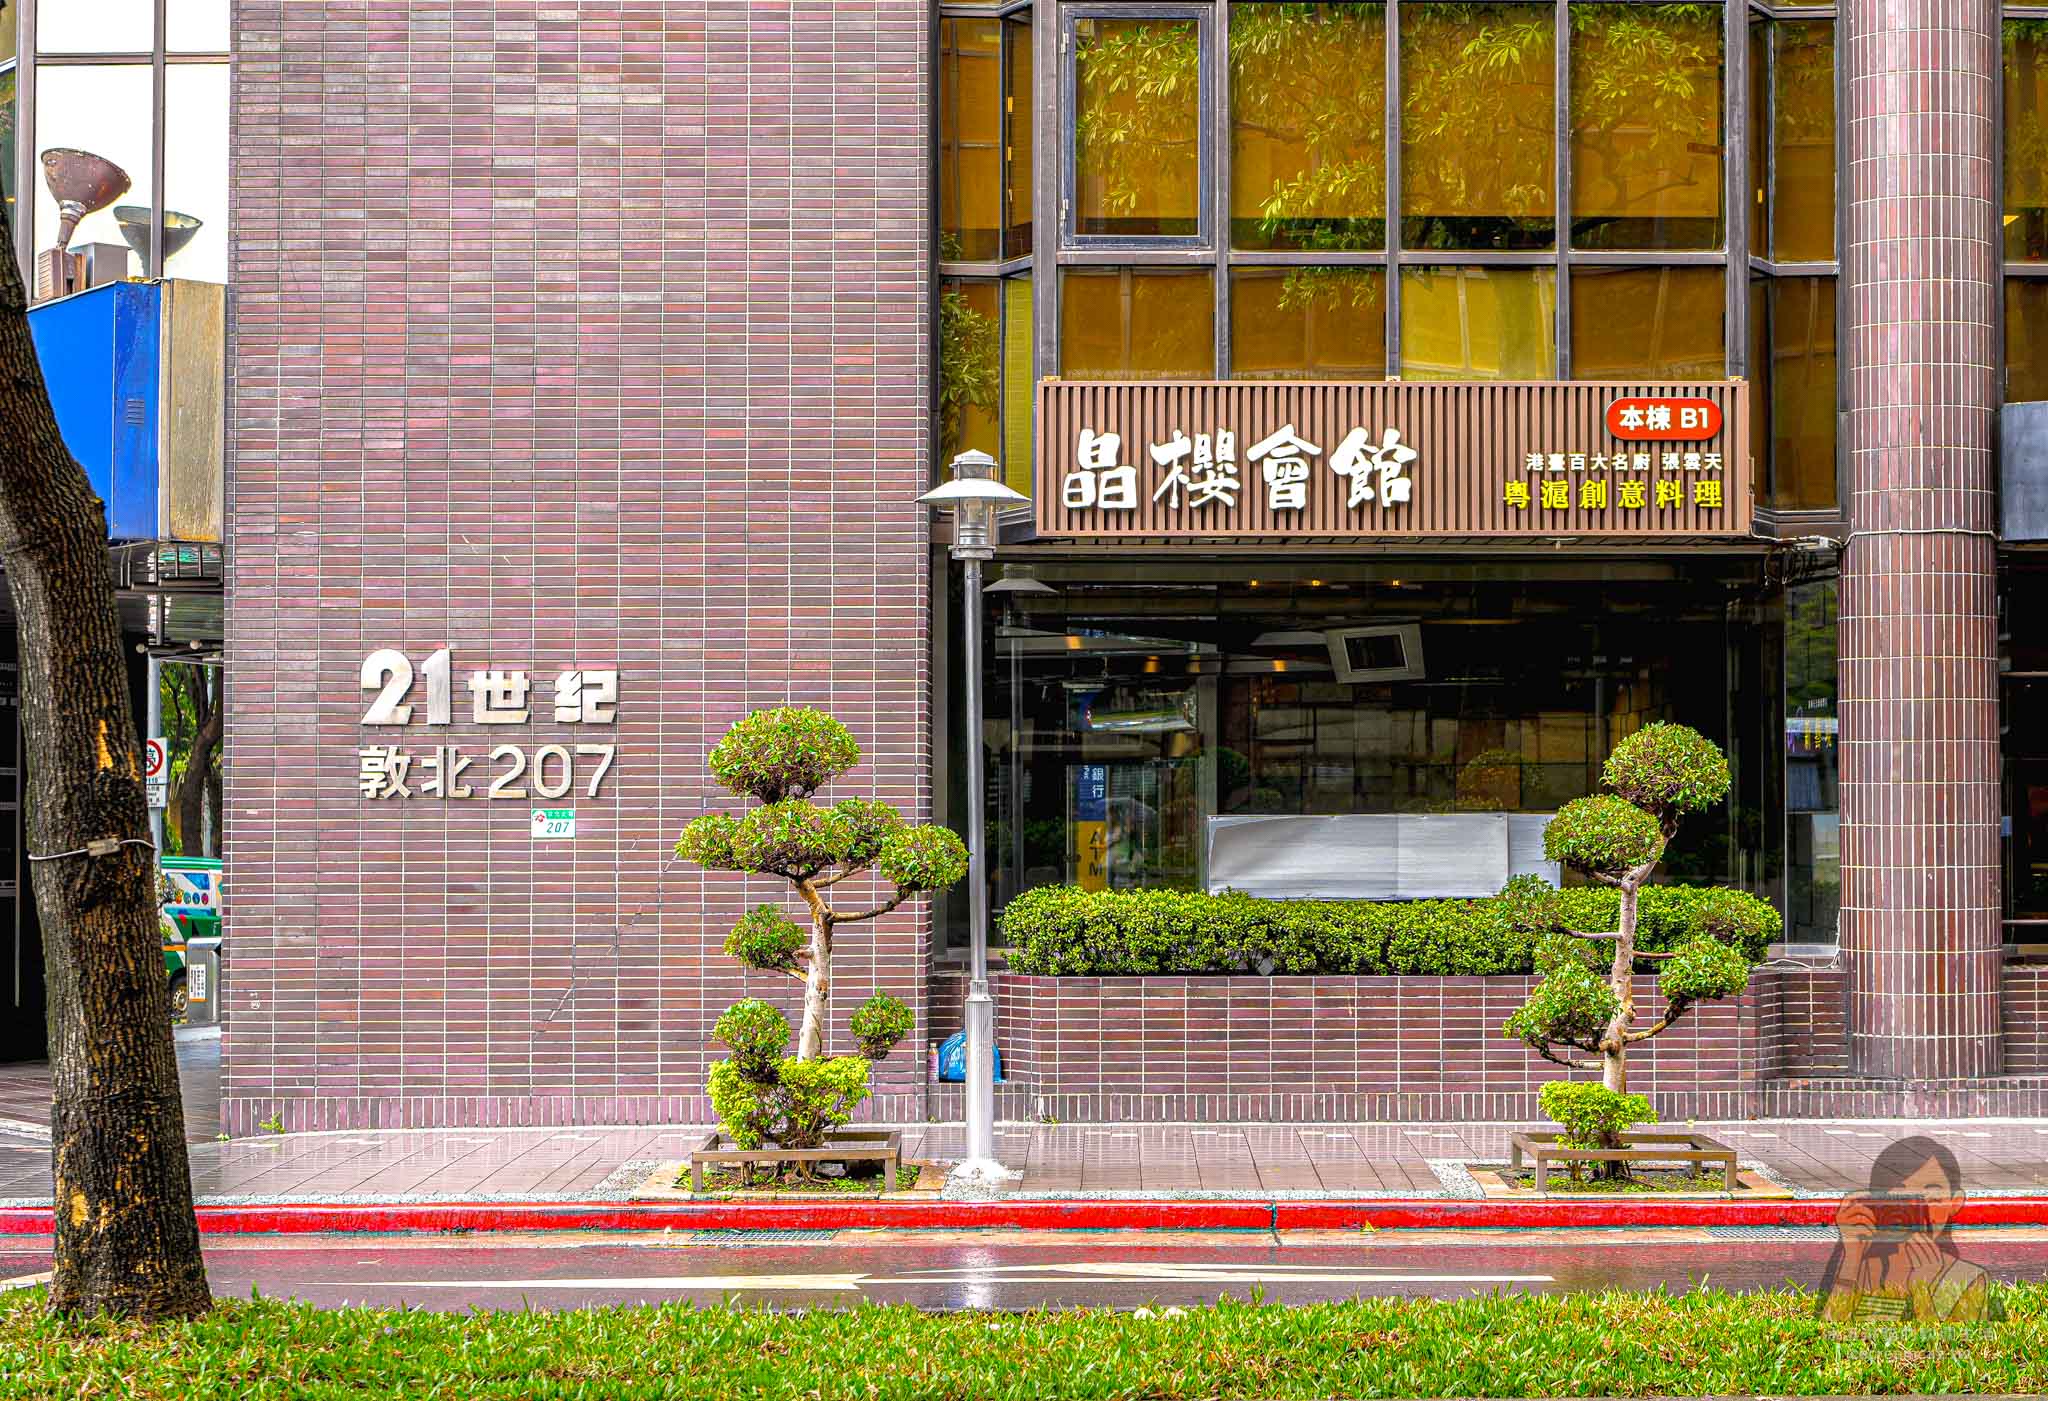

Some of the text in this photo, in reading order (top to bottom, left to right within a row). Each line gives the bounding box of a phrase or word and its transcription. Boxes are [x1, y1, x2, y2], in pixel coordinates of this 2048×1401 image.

[1620, 405, 1709, 431] 本棟 B1
[1063, 424, 1417, 509] 晶櫻會館
[1525, 452, 1723, 471] 港臺百大名廚 張雲天
[1503, 479, 1723, 509] 粵滬創意料理
[1092, 767, 1105, 798] 銀行
[546, 822, 570, 833] 207
[1089, 832, 1105, 876] ATM
